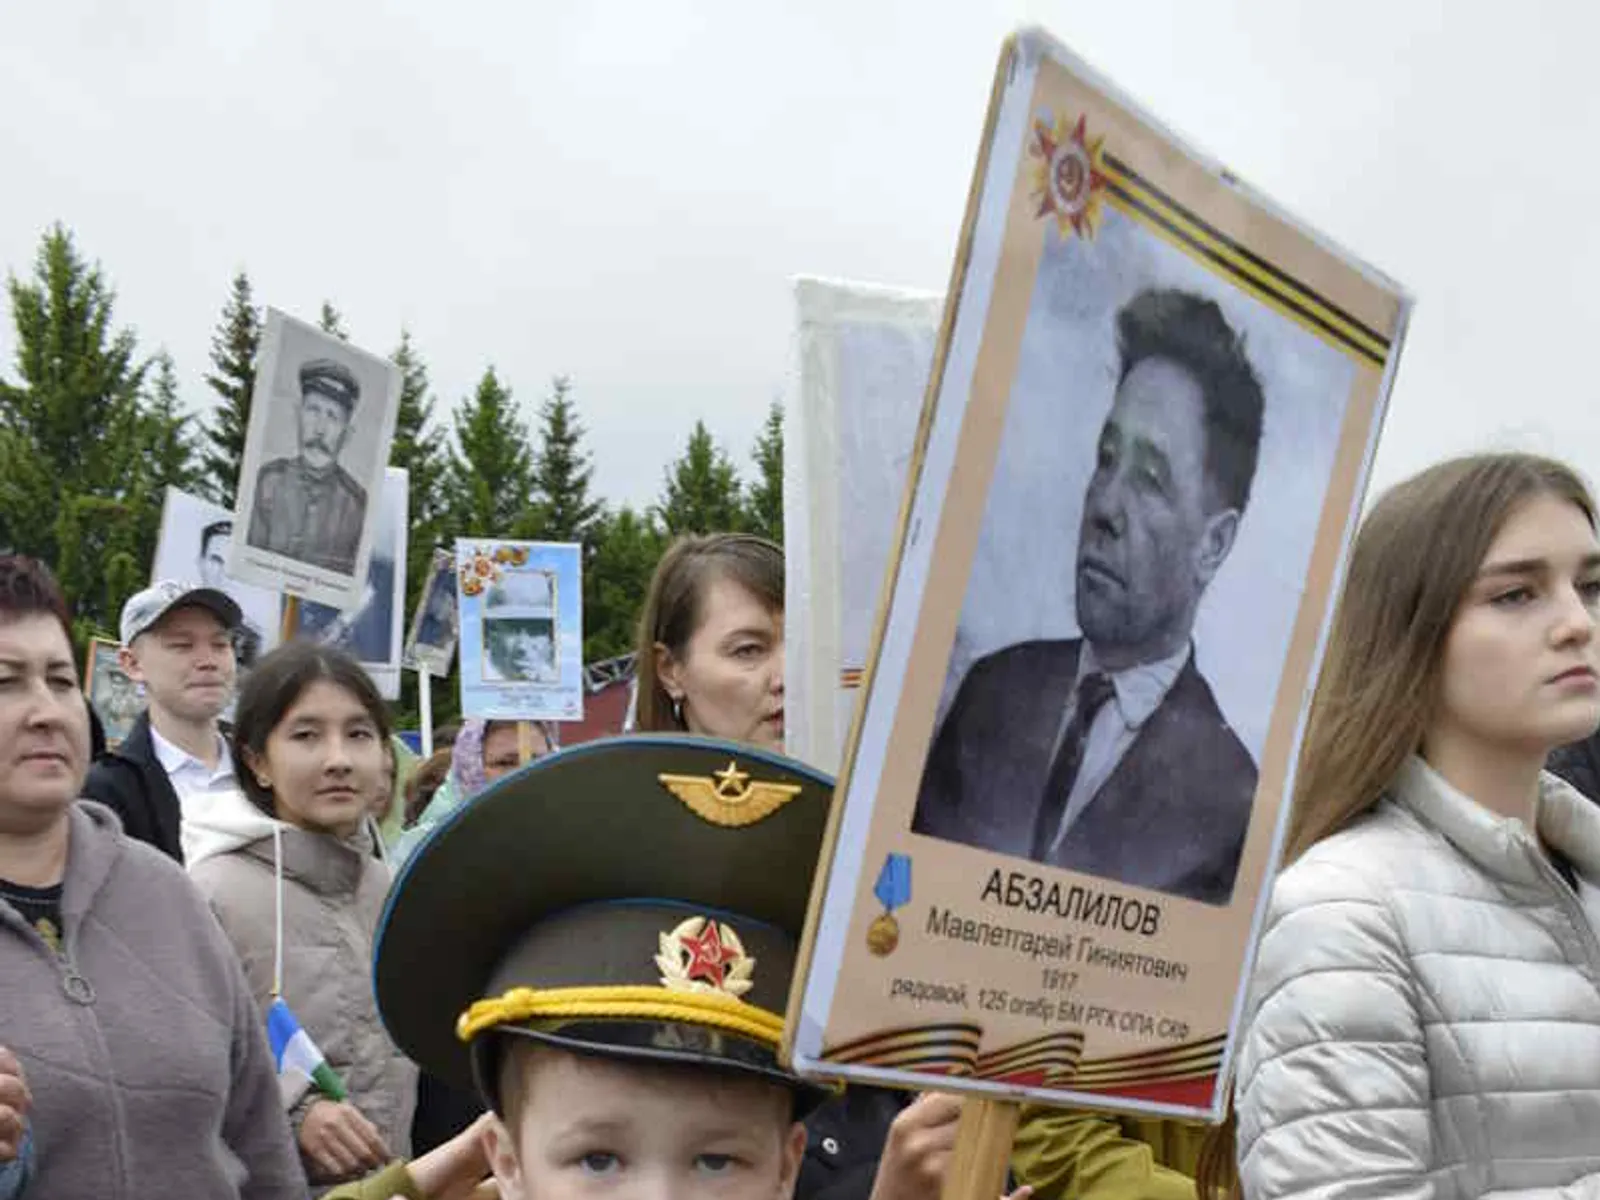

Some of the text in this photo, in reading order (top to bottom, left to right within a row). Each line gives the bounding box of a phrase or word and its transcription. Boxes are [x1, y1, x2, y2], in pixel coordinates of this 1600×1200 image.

[981, 868, 1161, 935] АБЗАЛИЛОВ
[1076, 936, 1189, 983] Гиниятович
[1041, 968, 1079, 990] 1917
[978, 988, 1007, 1011] 125
